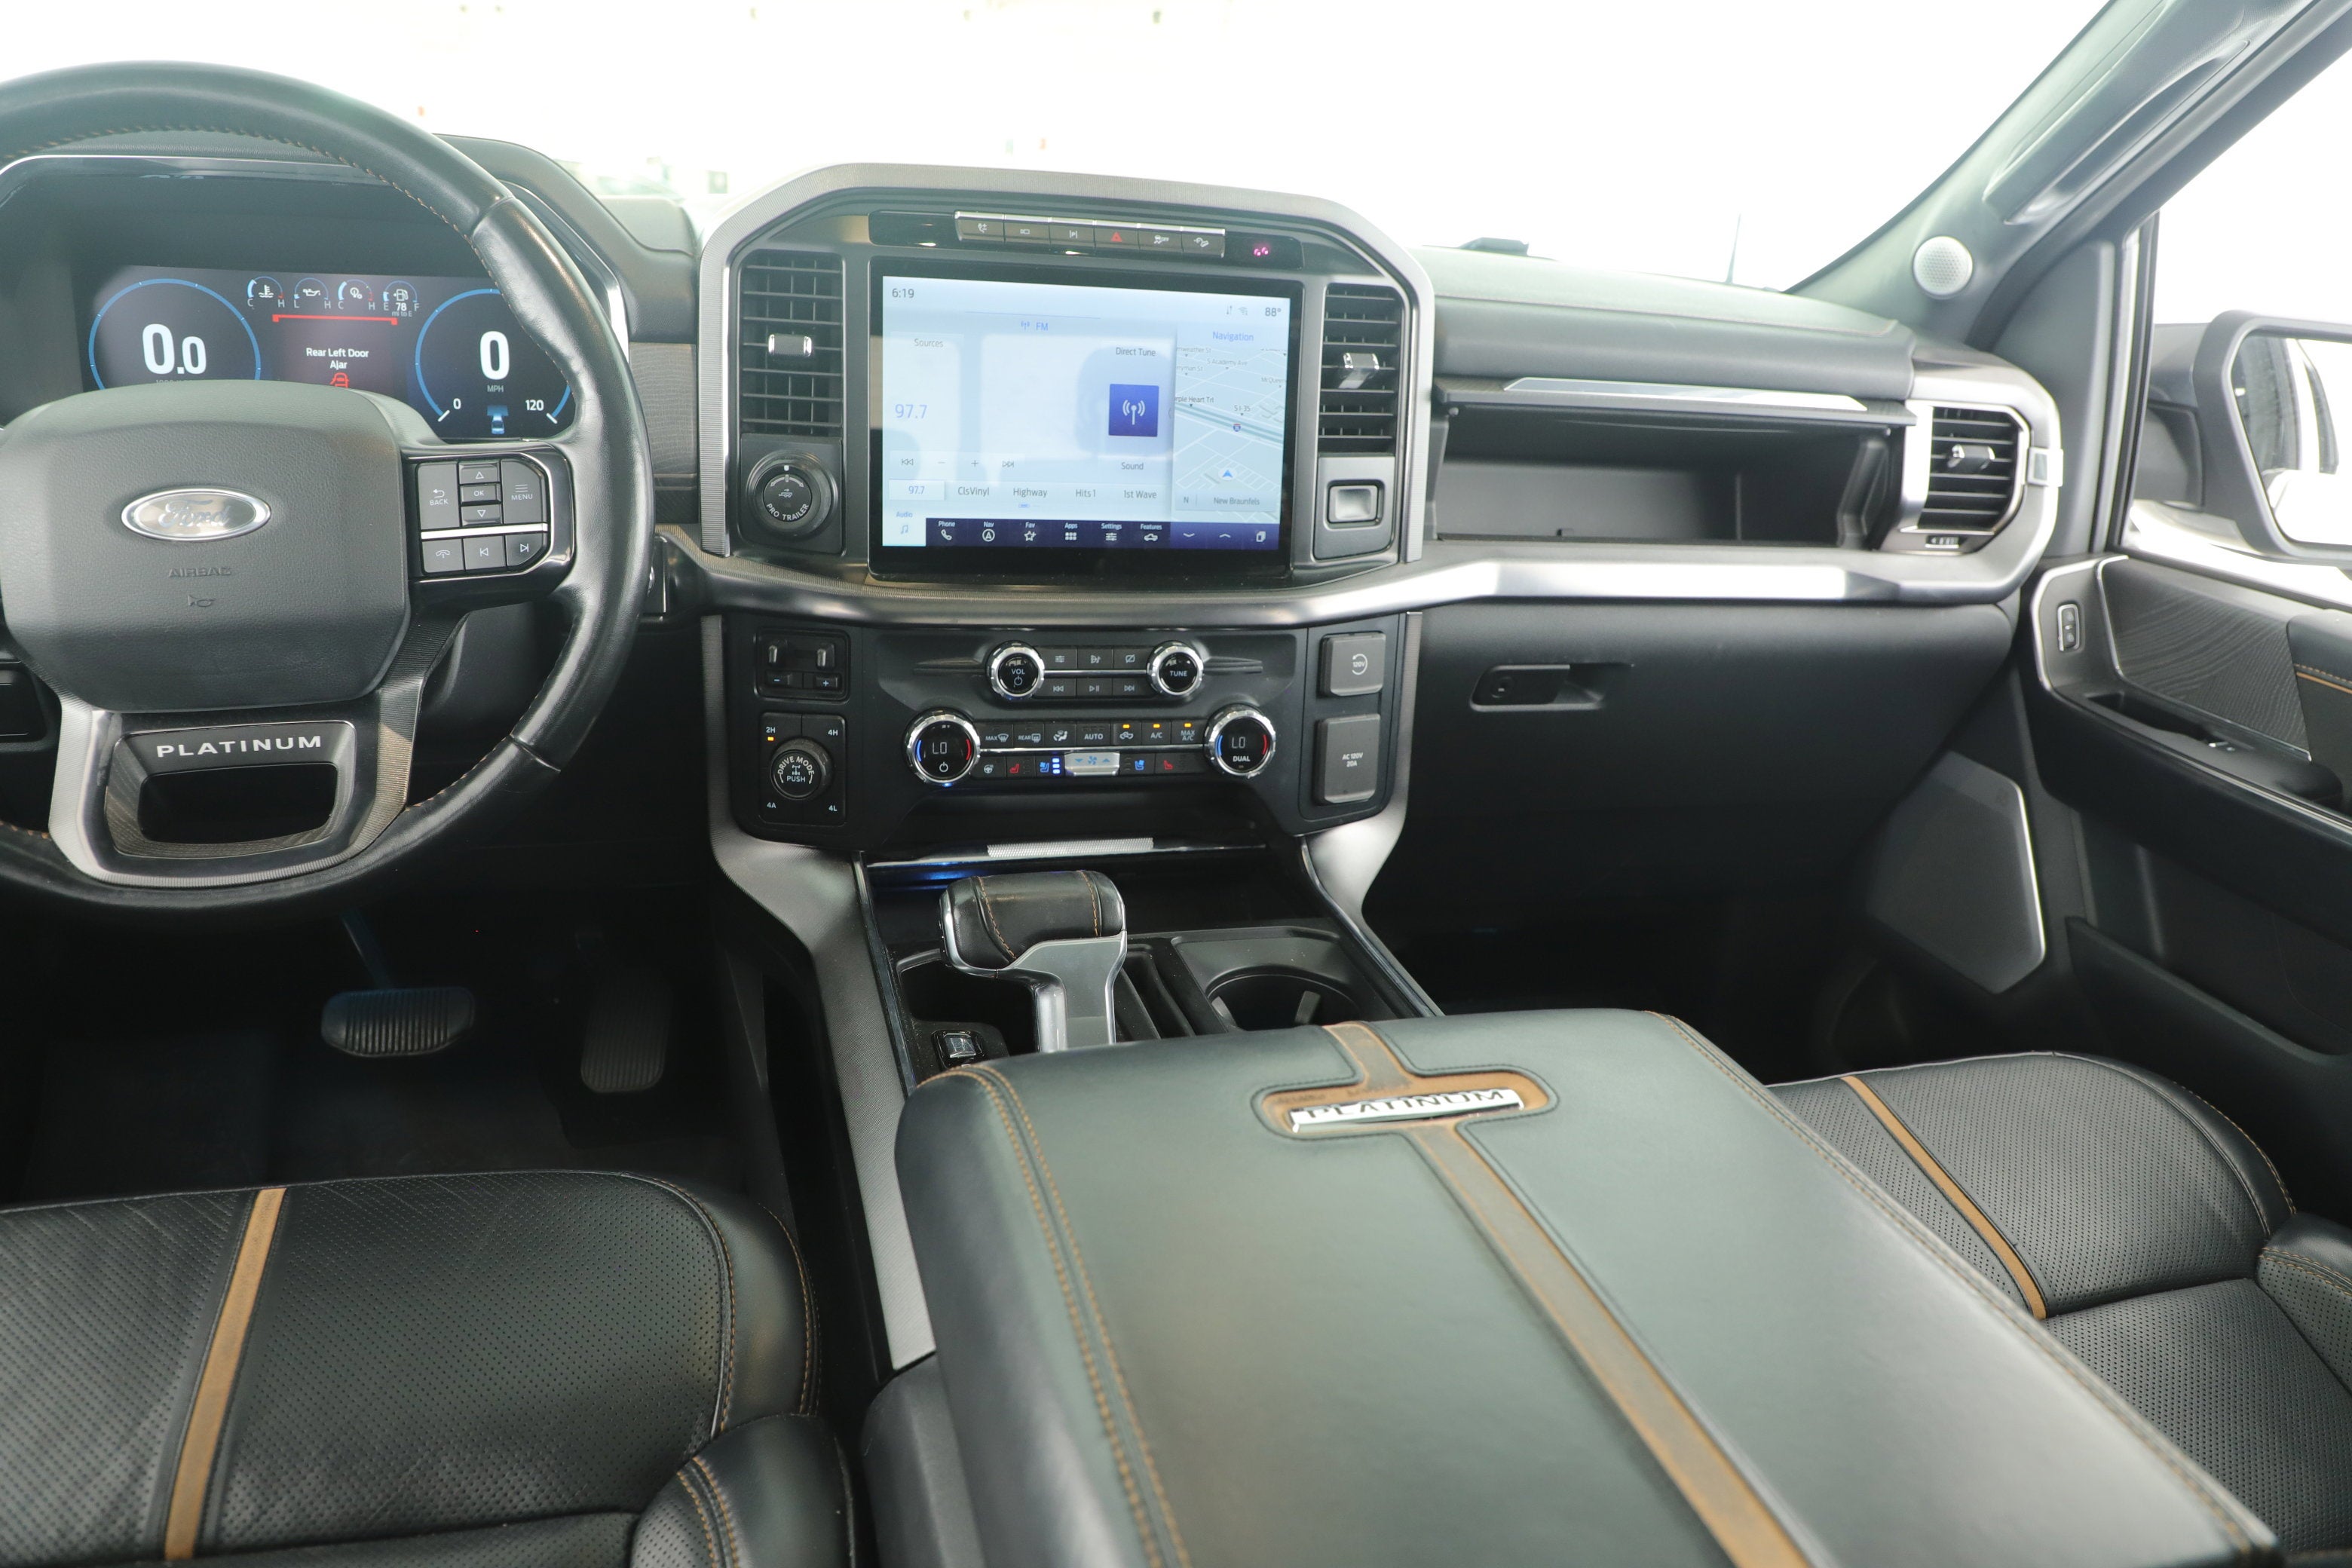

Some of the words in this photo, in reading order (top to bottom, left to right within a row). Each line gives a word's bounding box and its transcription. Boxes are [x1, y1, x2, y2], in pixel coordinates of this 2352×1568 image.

[892, 288, 914, 299] 6:19
[247, 299, 253, 307] C
[277, 299, 285, 308] H
[293, 300, 299, 308] L
[324, 301, 331, 309] H
[338, 302, 344, 310] C
[368, 302, 375, 311] H
[383, 302, 389, 311] E
[396, 302, 407, 311] 78
[414, 303, 420, 311] F
[1265, 308, 1282, 317] 88°
[1036, 322, 1049, 331] FM
[1212, 331, 1254, 342] Navigation
[914, 338, 944, 348] Sources
[142, 323, 207, 375] 0.0
[306, 348, 326, 357] Rear
[328, 348, 346, 357] Left
[348, 348, 369, 358] Door
[1116, 347, 1135, 357] Direct
[1136, 348, 1156, 357] Tune
[479, 330, 510, 380] 0
[329, 360, 348, 370] Ajar
[453, 398, 461, 409] 0
[525, 400, 544, 411] 120
[895, 404, 927, 419] 97.7
[1121, 461, 1144, 470] Sound
[908, 485, 925, 495] 97.7
[957, 486, 990, 497] ClsVinyl
[1012, 487, 1048, 498] Highway
[1124, 490, 1135, 498] 1st
[1136, 490, 1157, 499] Wave
[158, 499, 231, 528] Ford
[767, 503, 780, 518] PRO
[782, 504, 810, 521] TRAILER
[938, 520, 956, 528] Phone
[1101, 522, 1122, 531] Settings
[168, 567, 231, 577] AIRBAG
[156, 735, 321, 758] PLATINUM
[1231, 737, 1246, 749] LO
[932, 742, 948, 755] LO
[777, 756, 795, 776] DRIVE
[796, 755, 815, 776] MODE
[1306, 1089, 1505, 1119] PLATINUM
